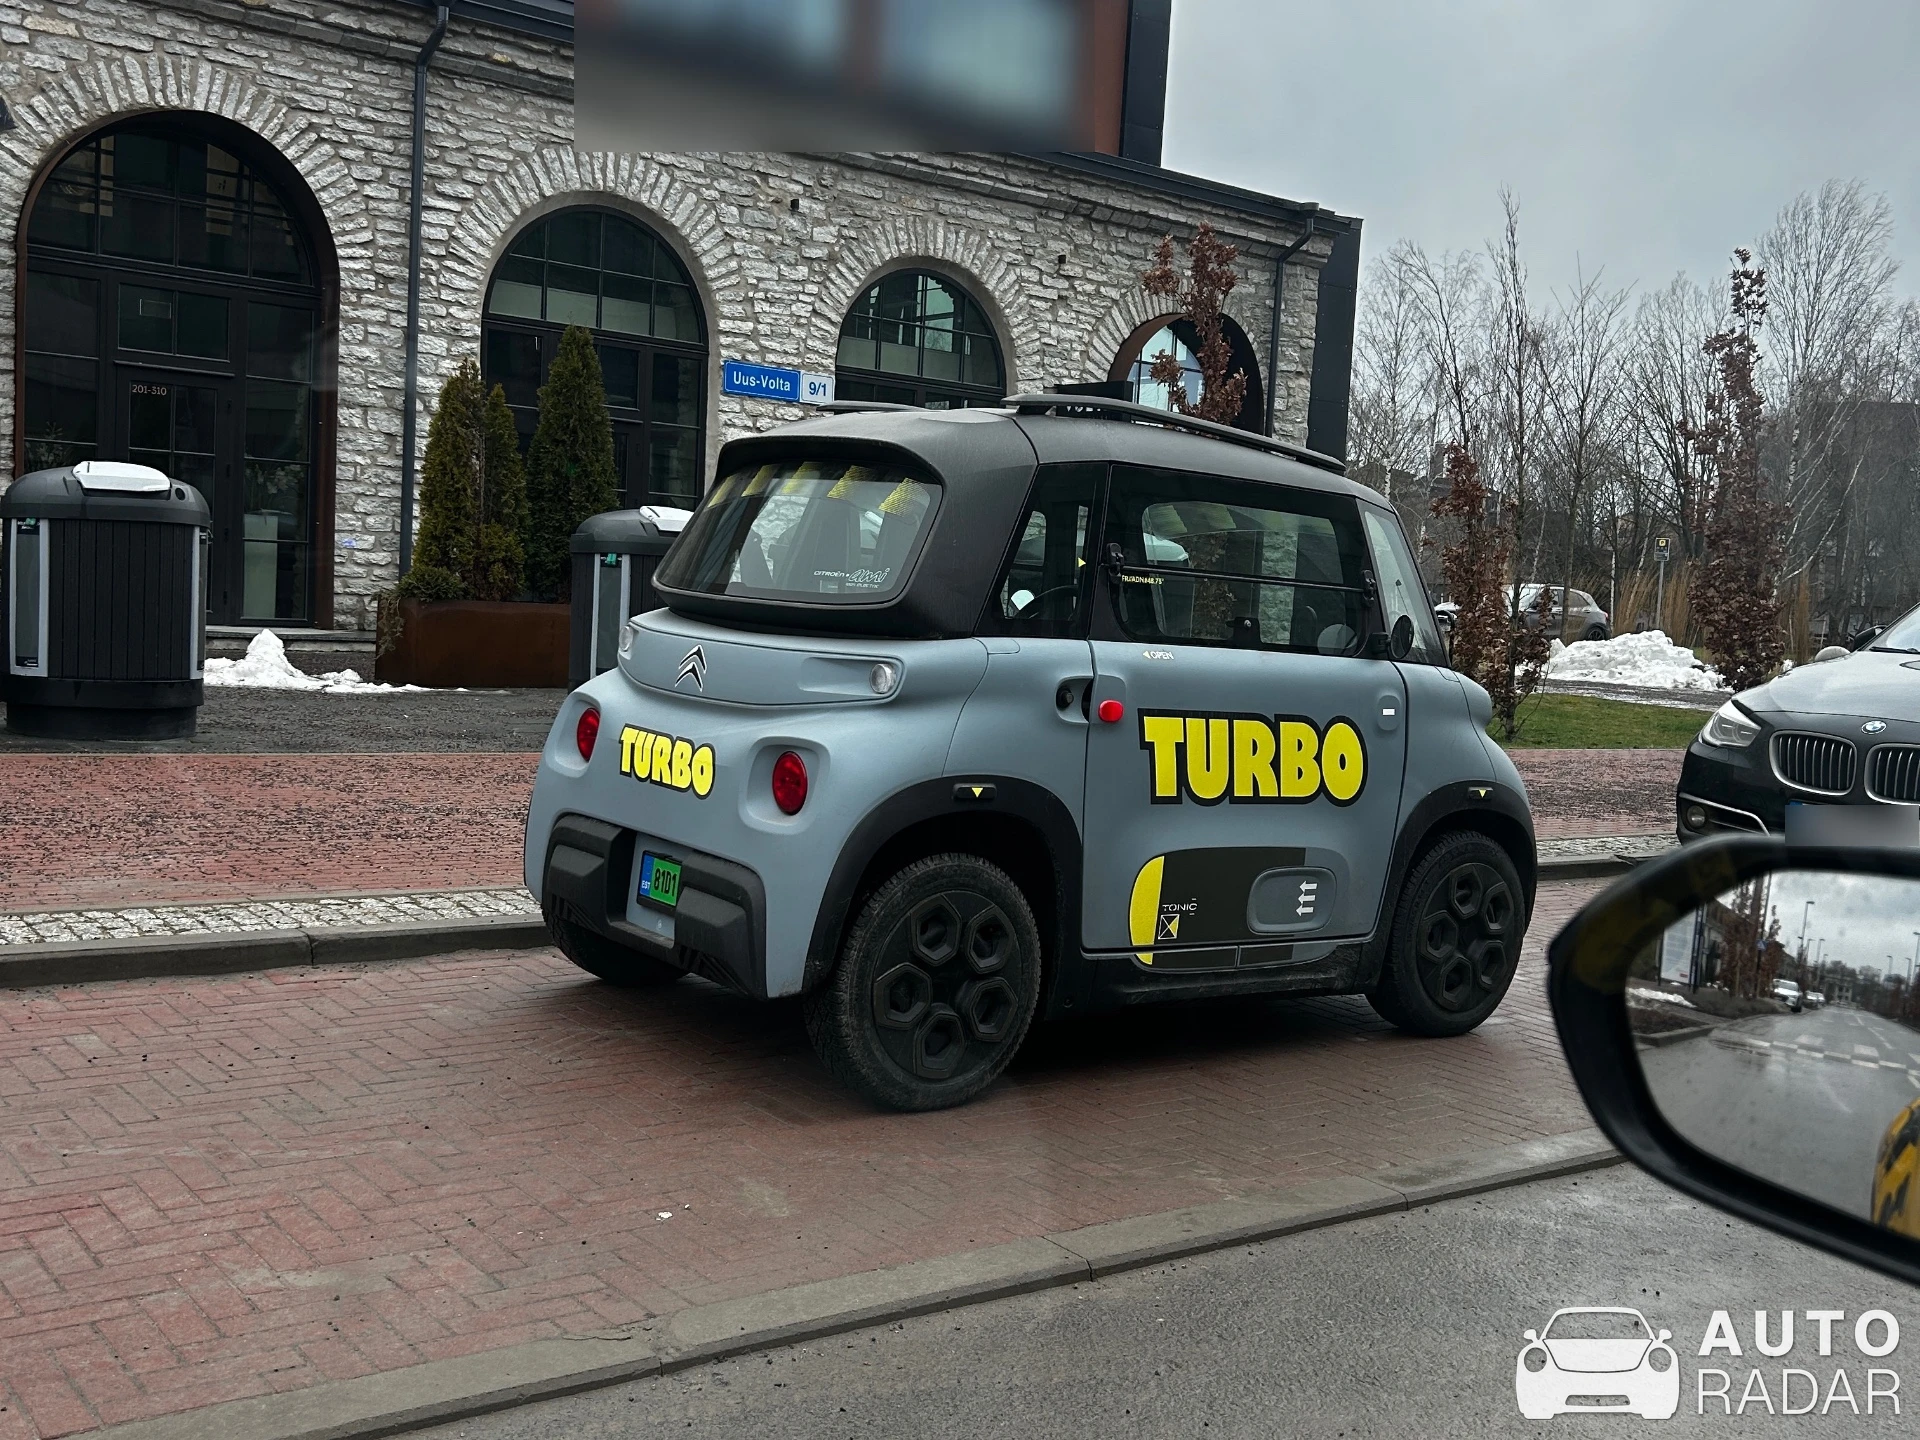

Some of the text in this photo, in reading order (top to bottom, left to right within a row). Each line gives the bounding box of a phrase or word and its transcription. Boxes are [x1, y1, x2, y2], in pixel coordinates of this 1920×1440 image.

[132, 384, 167, 396] 201-310
[733, 371, 827, 397] Uus-Volta 9/1
[1150, 651, 1175, 660] OPEN
[620, 725, 715, 797] TURBO
[1141, 714, 1365, 802] TURBO
[641, 867, 678, 897] EST 81D1
[1162, 902, 1198, 912] TONIC
